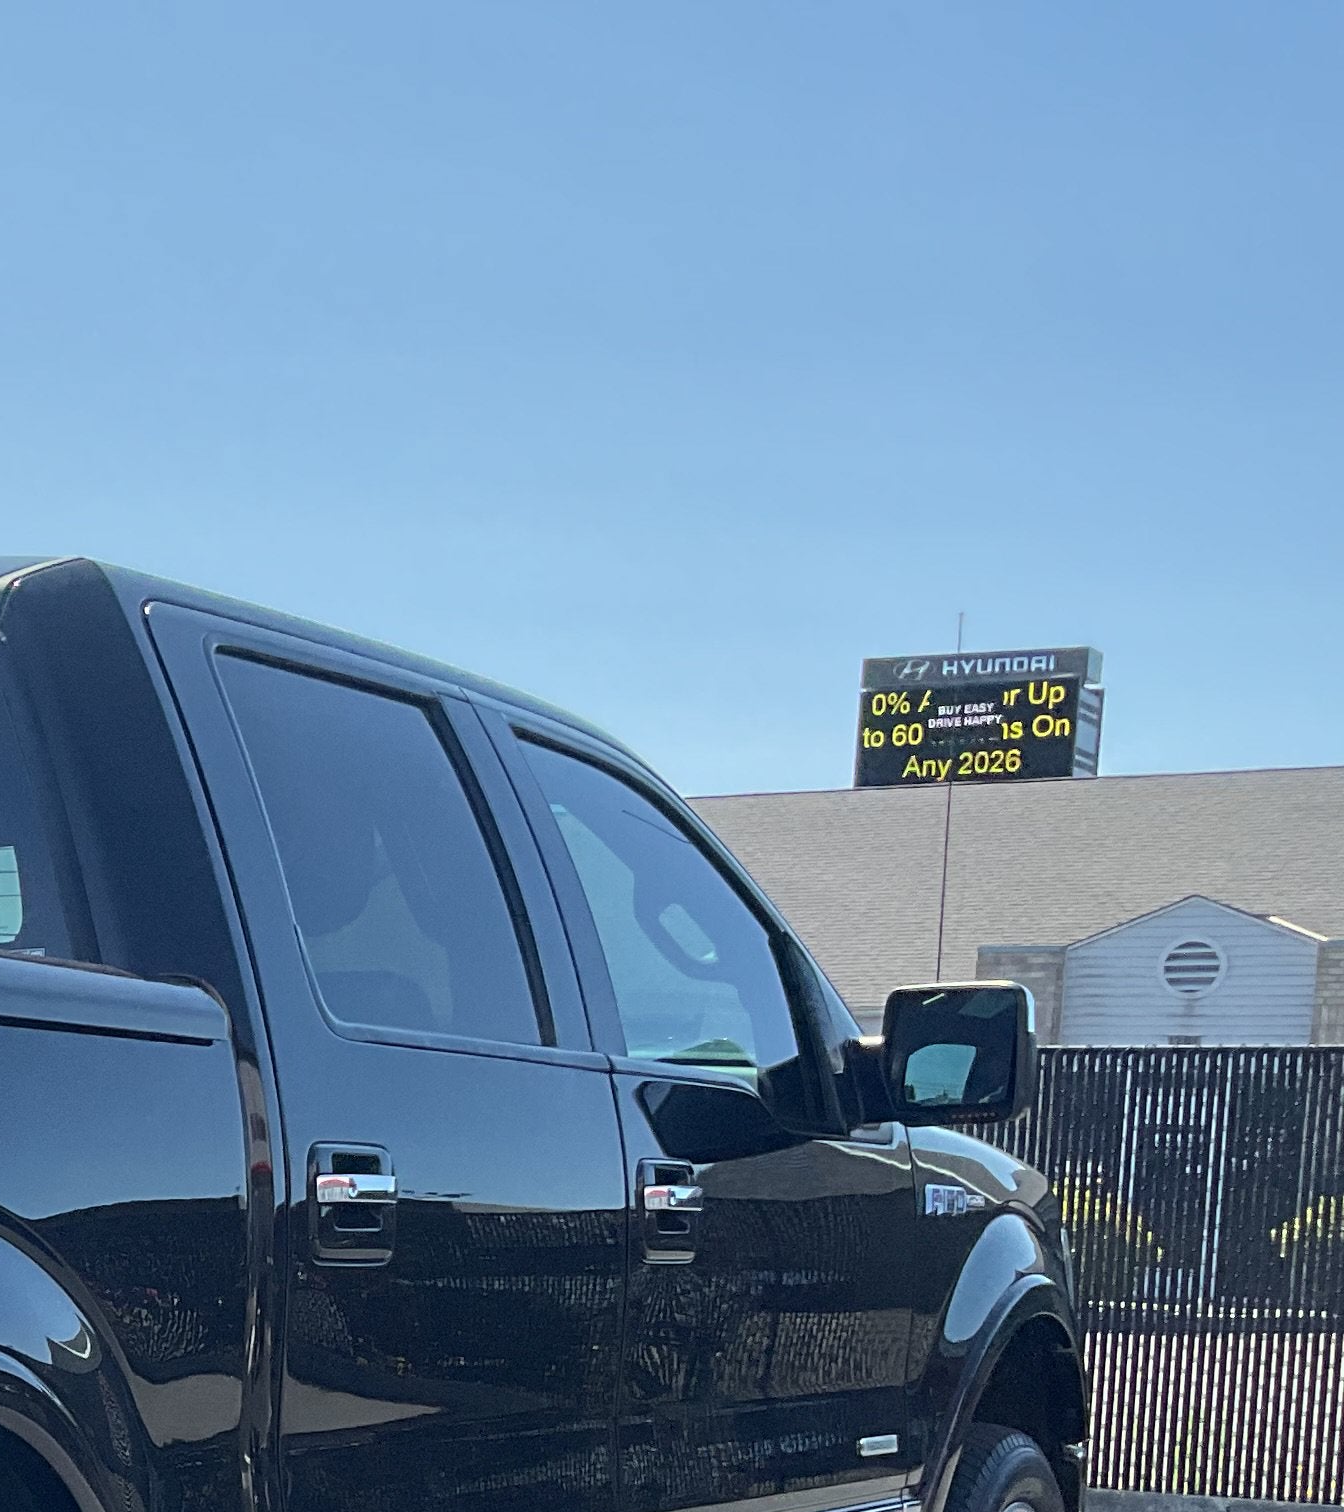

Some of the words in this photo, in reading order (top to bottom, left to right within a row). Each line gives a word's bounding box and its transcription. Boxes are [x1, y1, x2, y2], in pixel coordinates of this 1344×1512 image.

[942, 655, 1055, 676] HYUNDAI
[872, 691, 911, 716] 0%
[1028, 681, 1065, 709] Up
[938, 704, 962, 716] BUY
[963, 702, 995, 715] EASY
[863, 727, 885, 748] to
[892, 722, 923, 746] 60
[1032, 714, 1070, 737] On
[928, 717, 962, 729] DRIVE
[963, 714, 1003, 727] HAPPY
[901, 754, 952, 782] Any
[957, 748, 1021, 775] 2026
